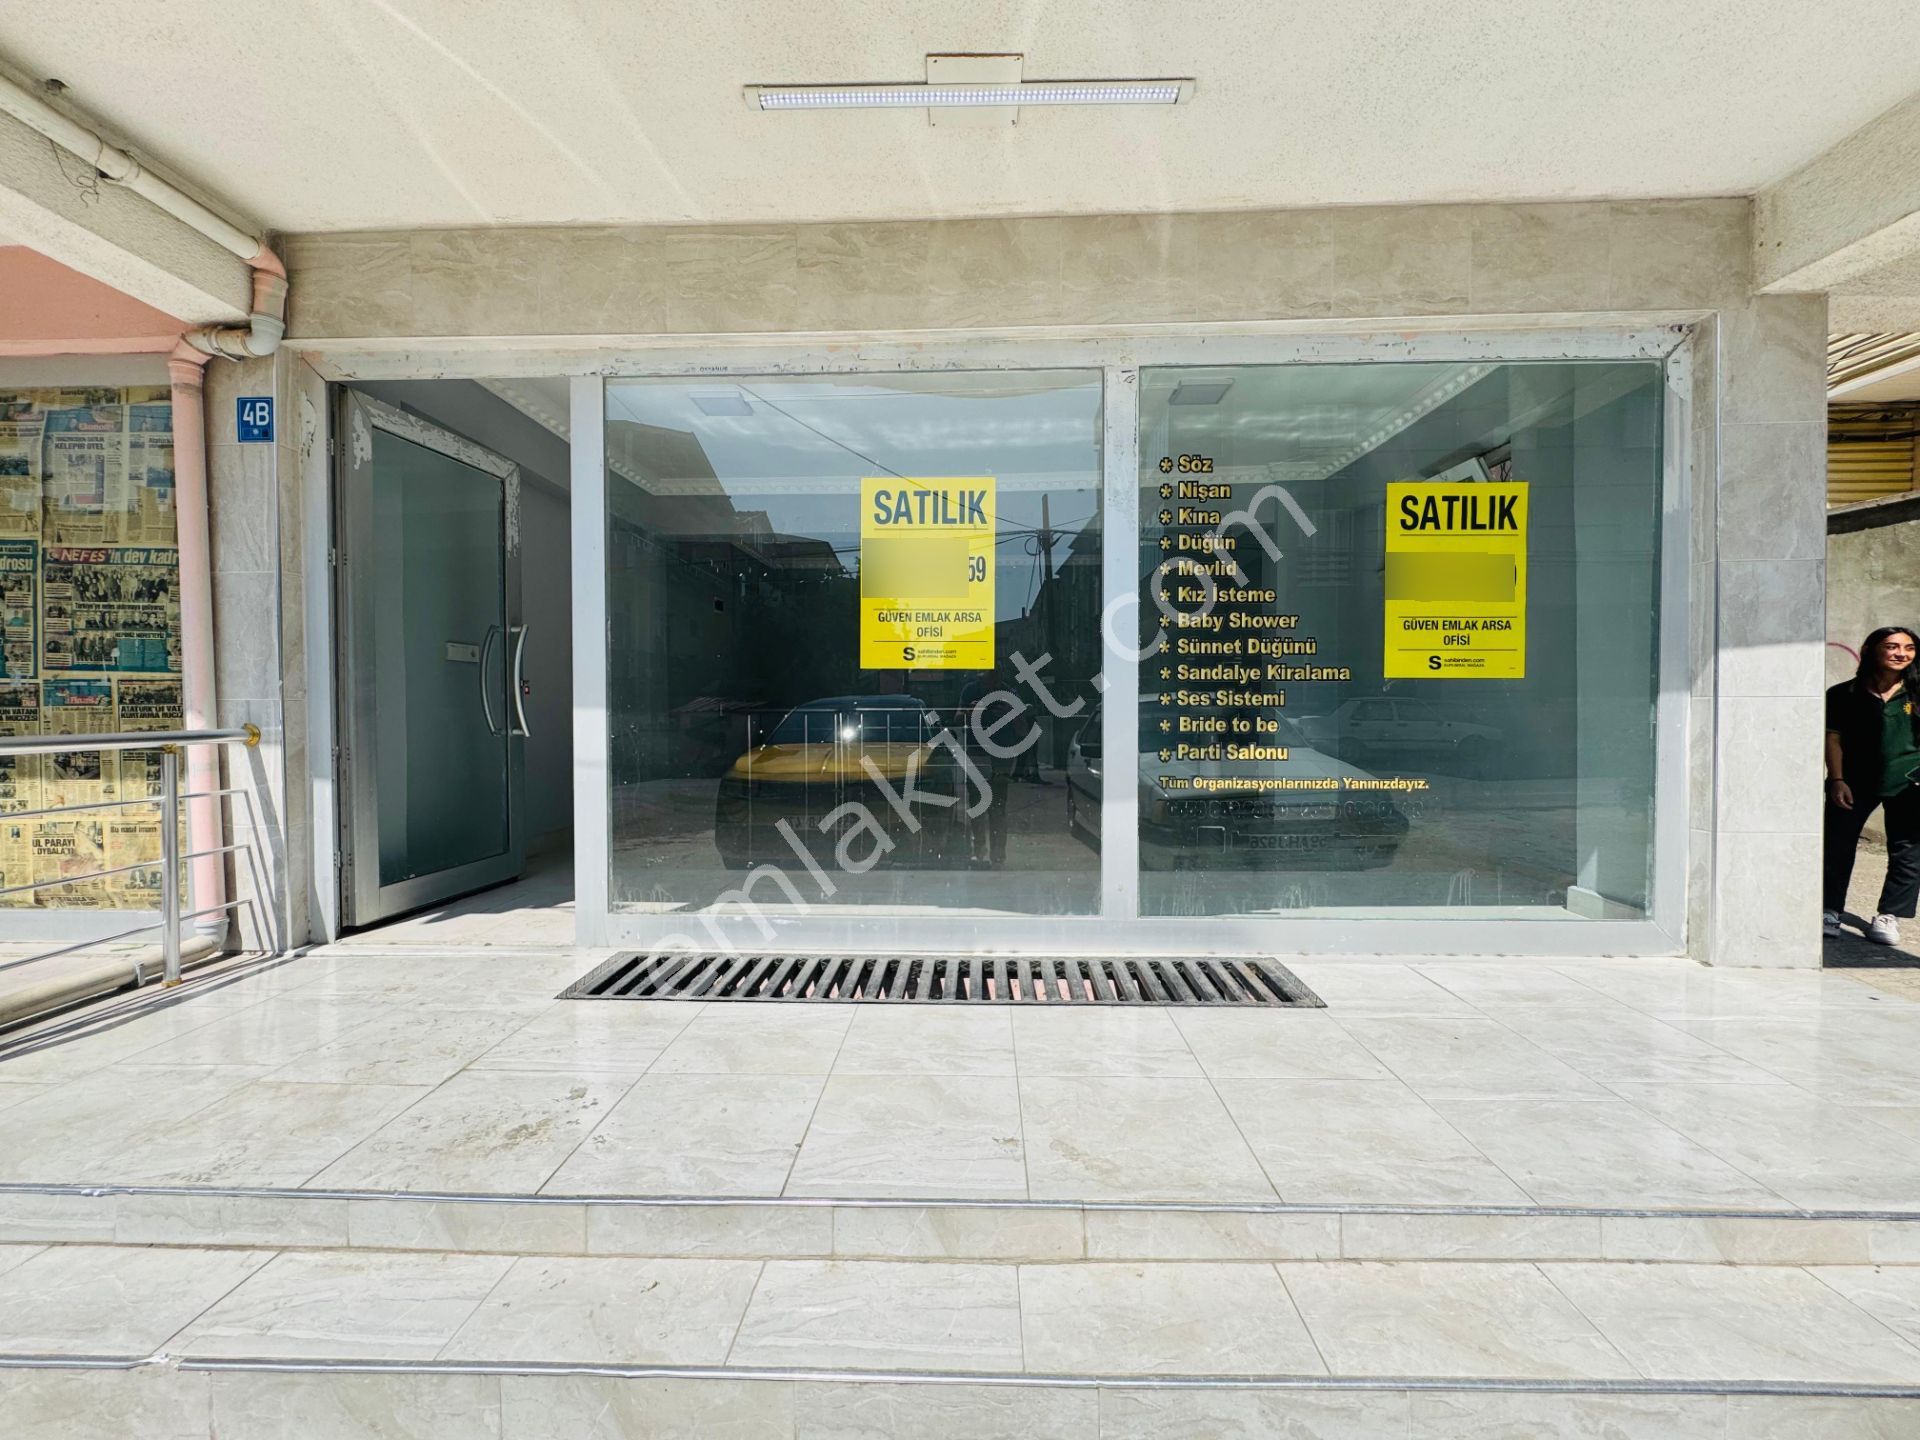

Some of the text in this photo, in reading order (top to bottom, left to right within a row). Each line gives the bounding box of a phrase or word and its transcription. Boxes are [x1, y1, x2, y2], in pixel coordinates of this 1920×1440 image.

[243, 402, 270, 426] 4B
[1178, 455, 1213, 473] Söz
[1178, 481, 1231, 502] Nişan
[874, 490, 988, 525] SATILIK
[1400, 495, 1518, 530] SATILIK
[1178, 508, 1221, 525] Kına
[1178, 534, 1236, 554] Düğün
[124, 551, 145, 563] dev
[1178, 560, 1237, 577] Mevlid
[1178, 583, 1276, 602] Kız İsteme
[878, 608, 982, 623] GÜVEN EMLAK ARSA
[1177, 613, 1299, 632] Baby Shower
[1403, 617, 1512, 631] GÜVEN EMLAK ARSA
[917, 626, 943, 638] OFİSİ
[1443, 632, 1471, 646] OFİSİ
[1177, 638, 1316, 658] Sünnet Düğünü
[1177, 665, 1352, 684] Sandalye Kiralama
[1177, 690, 1285, 706] Ses Sistemi
[1179, 716, 1279, 733] Bride to be
[1177, 744, 1288, 761] Parti Salonu
[1160, 777, 1429, 792] Tüm Organizasyonlarınızda Yanınızdayız.
